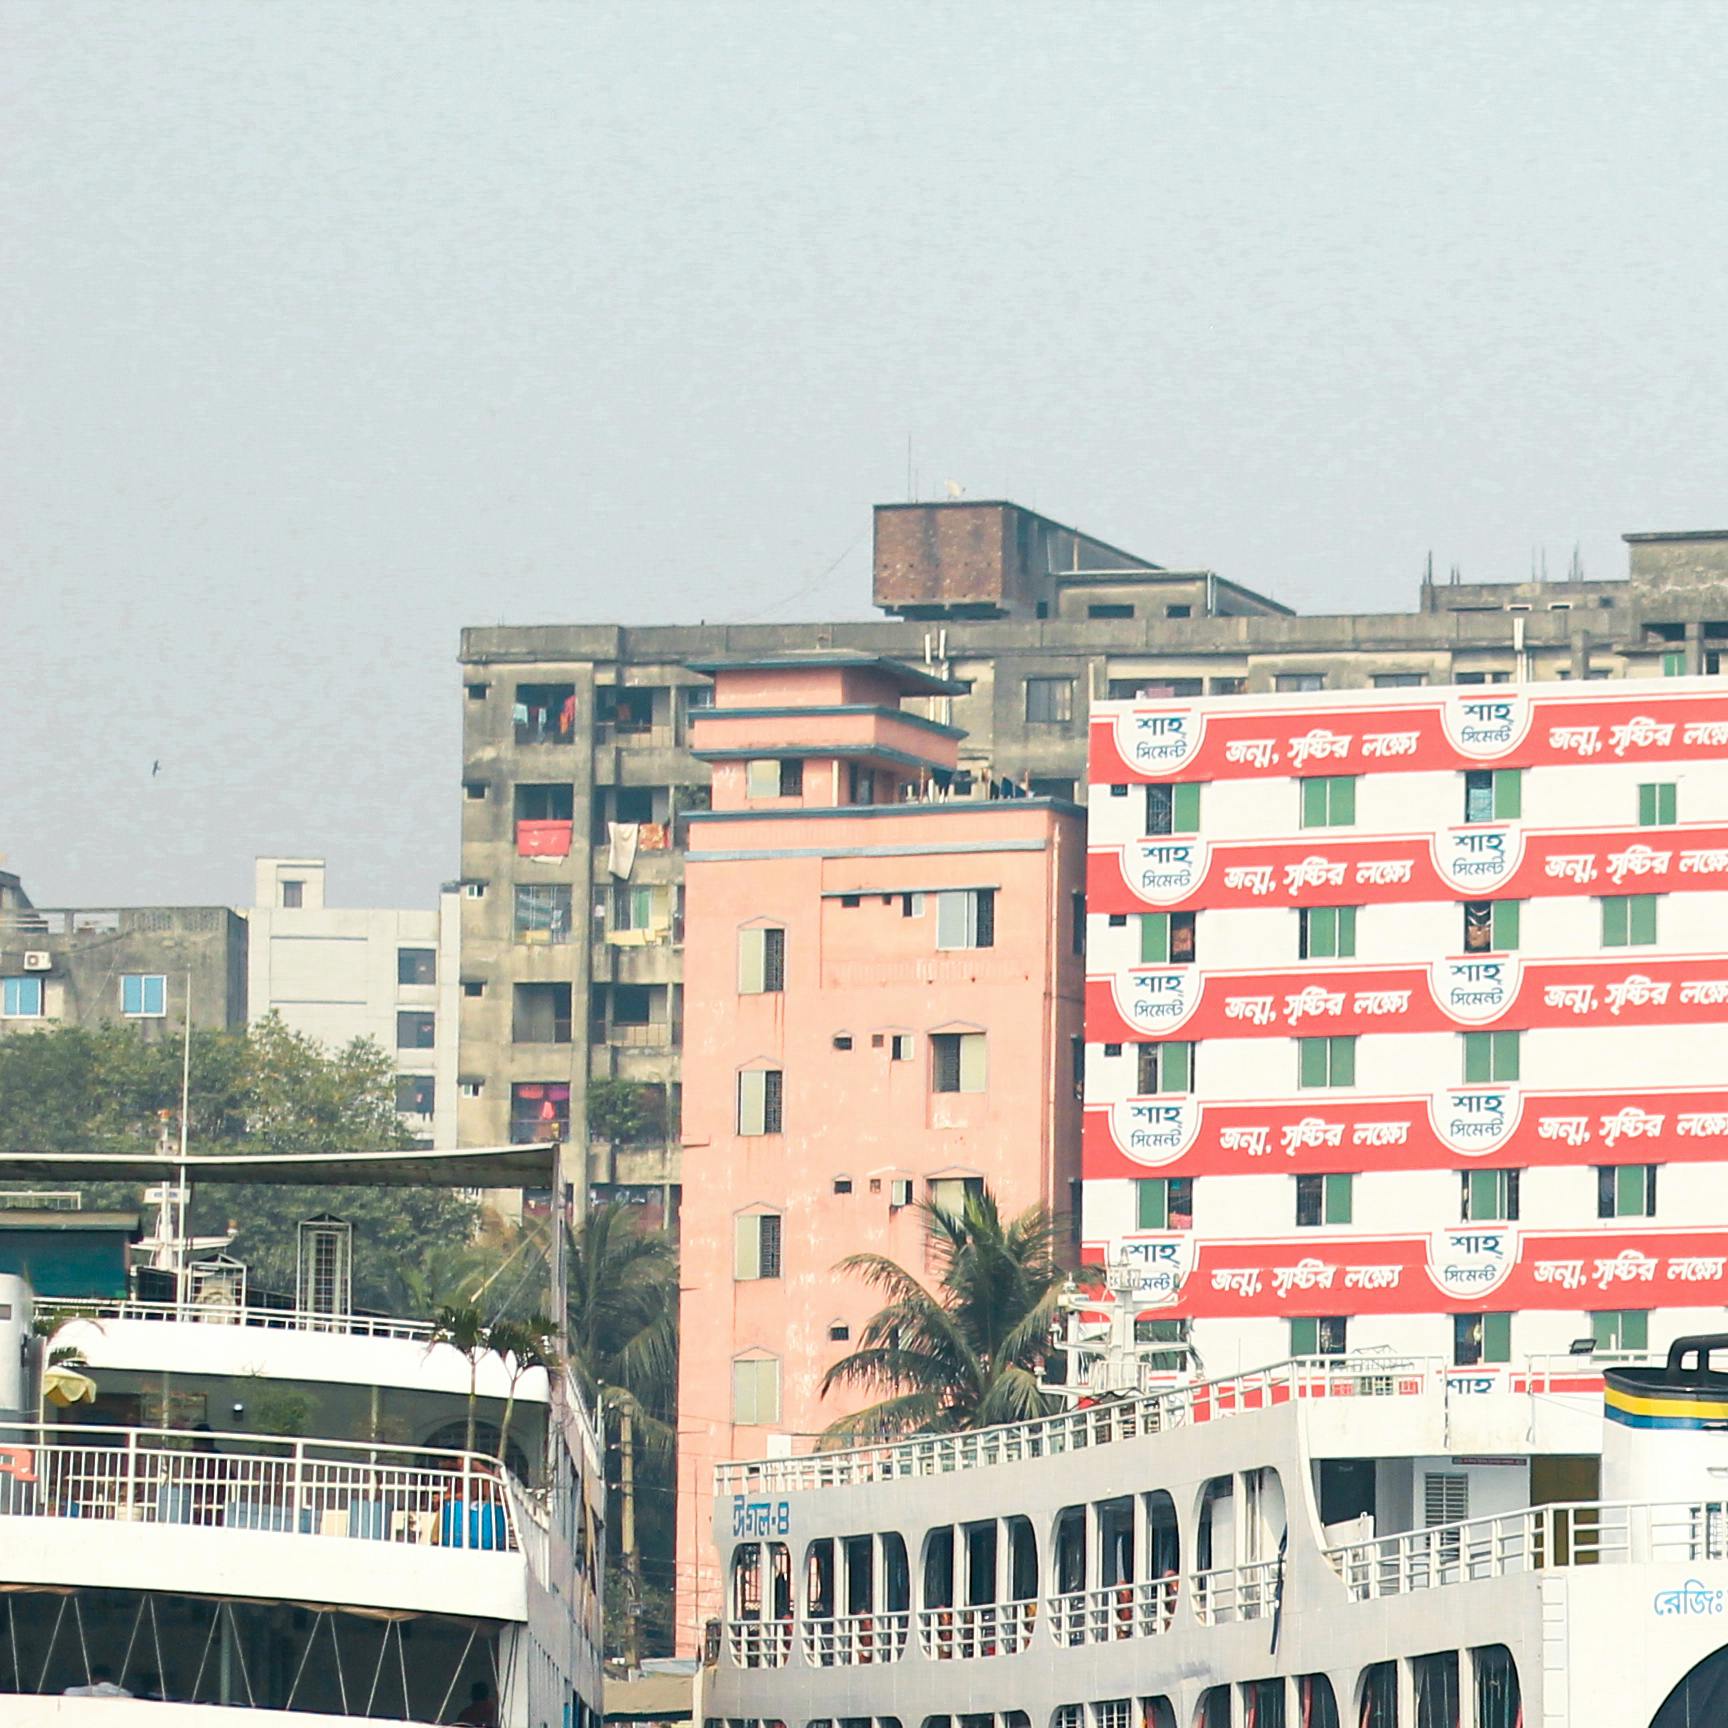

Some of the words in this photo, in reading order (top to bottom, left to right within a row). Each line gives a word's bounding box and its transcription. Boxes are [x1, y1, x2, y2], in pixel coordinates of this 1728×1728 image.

[1136, 740, 1187, 759] সিমেন্ট
[1287, 729, 1354, 769] সৃষ্টির
[1461, 726, 1512, 744] সিমেন্ট
[1608, 716, 1676, 757] সৃষ্টির
[1142, 870, 1192, 889] সিমেন্ট
[1283, 856, 1348, 896] সৃষ্টির
[1452, 858, 1505, 875] সিমেন্ট
[1606, 844, 1674, 884] সৃষ্টির
[1134, 1000, 1185, 1018] সিমেন্ট
[1283, 985, 1347, 1026] সৃষ্টির
[1451, 986, 1504, 1006] সিমেন্ট
[1604, 974, 1673, 1015] সৃষ্টির
[1130, 1128, 1183, 1148] সিমেন্ট
[1280, 1117, 1346, 1156] সৃষ্টির
[1450, 1118, 1504, 1137] সিমেন্ট
[1598, 1106, 1666, 1147] সৃষ্টির
[1271, 1258, 1341, 1298] সৃষ্টির
[1444, 1264, 1496, 1282] সিমেন্ট
[1592, 1249, 1660, 1290] সৃষ্টির
[733, 1495, 789, 1537] ঈগল-৪
